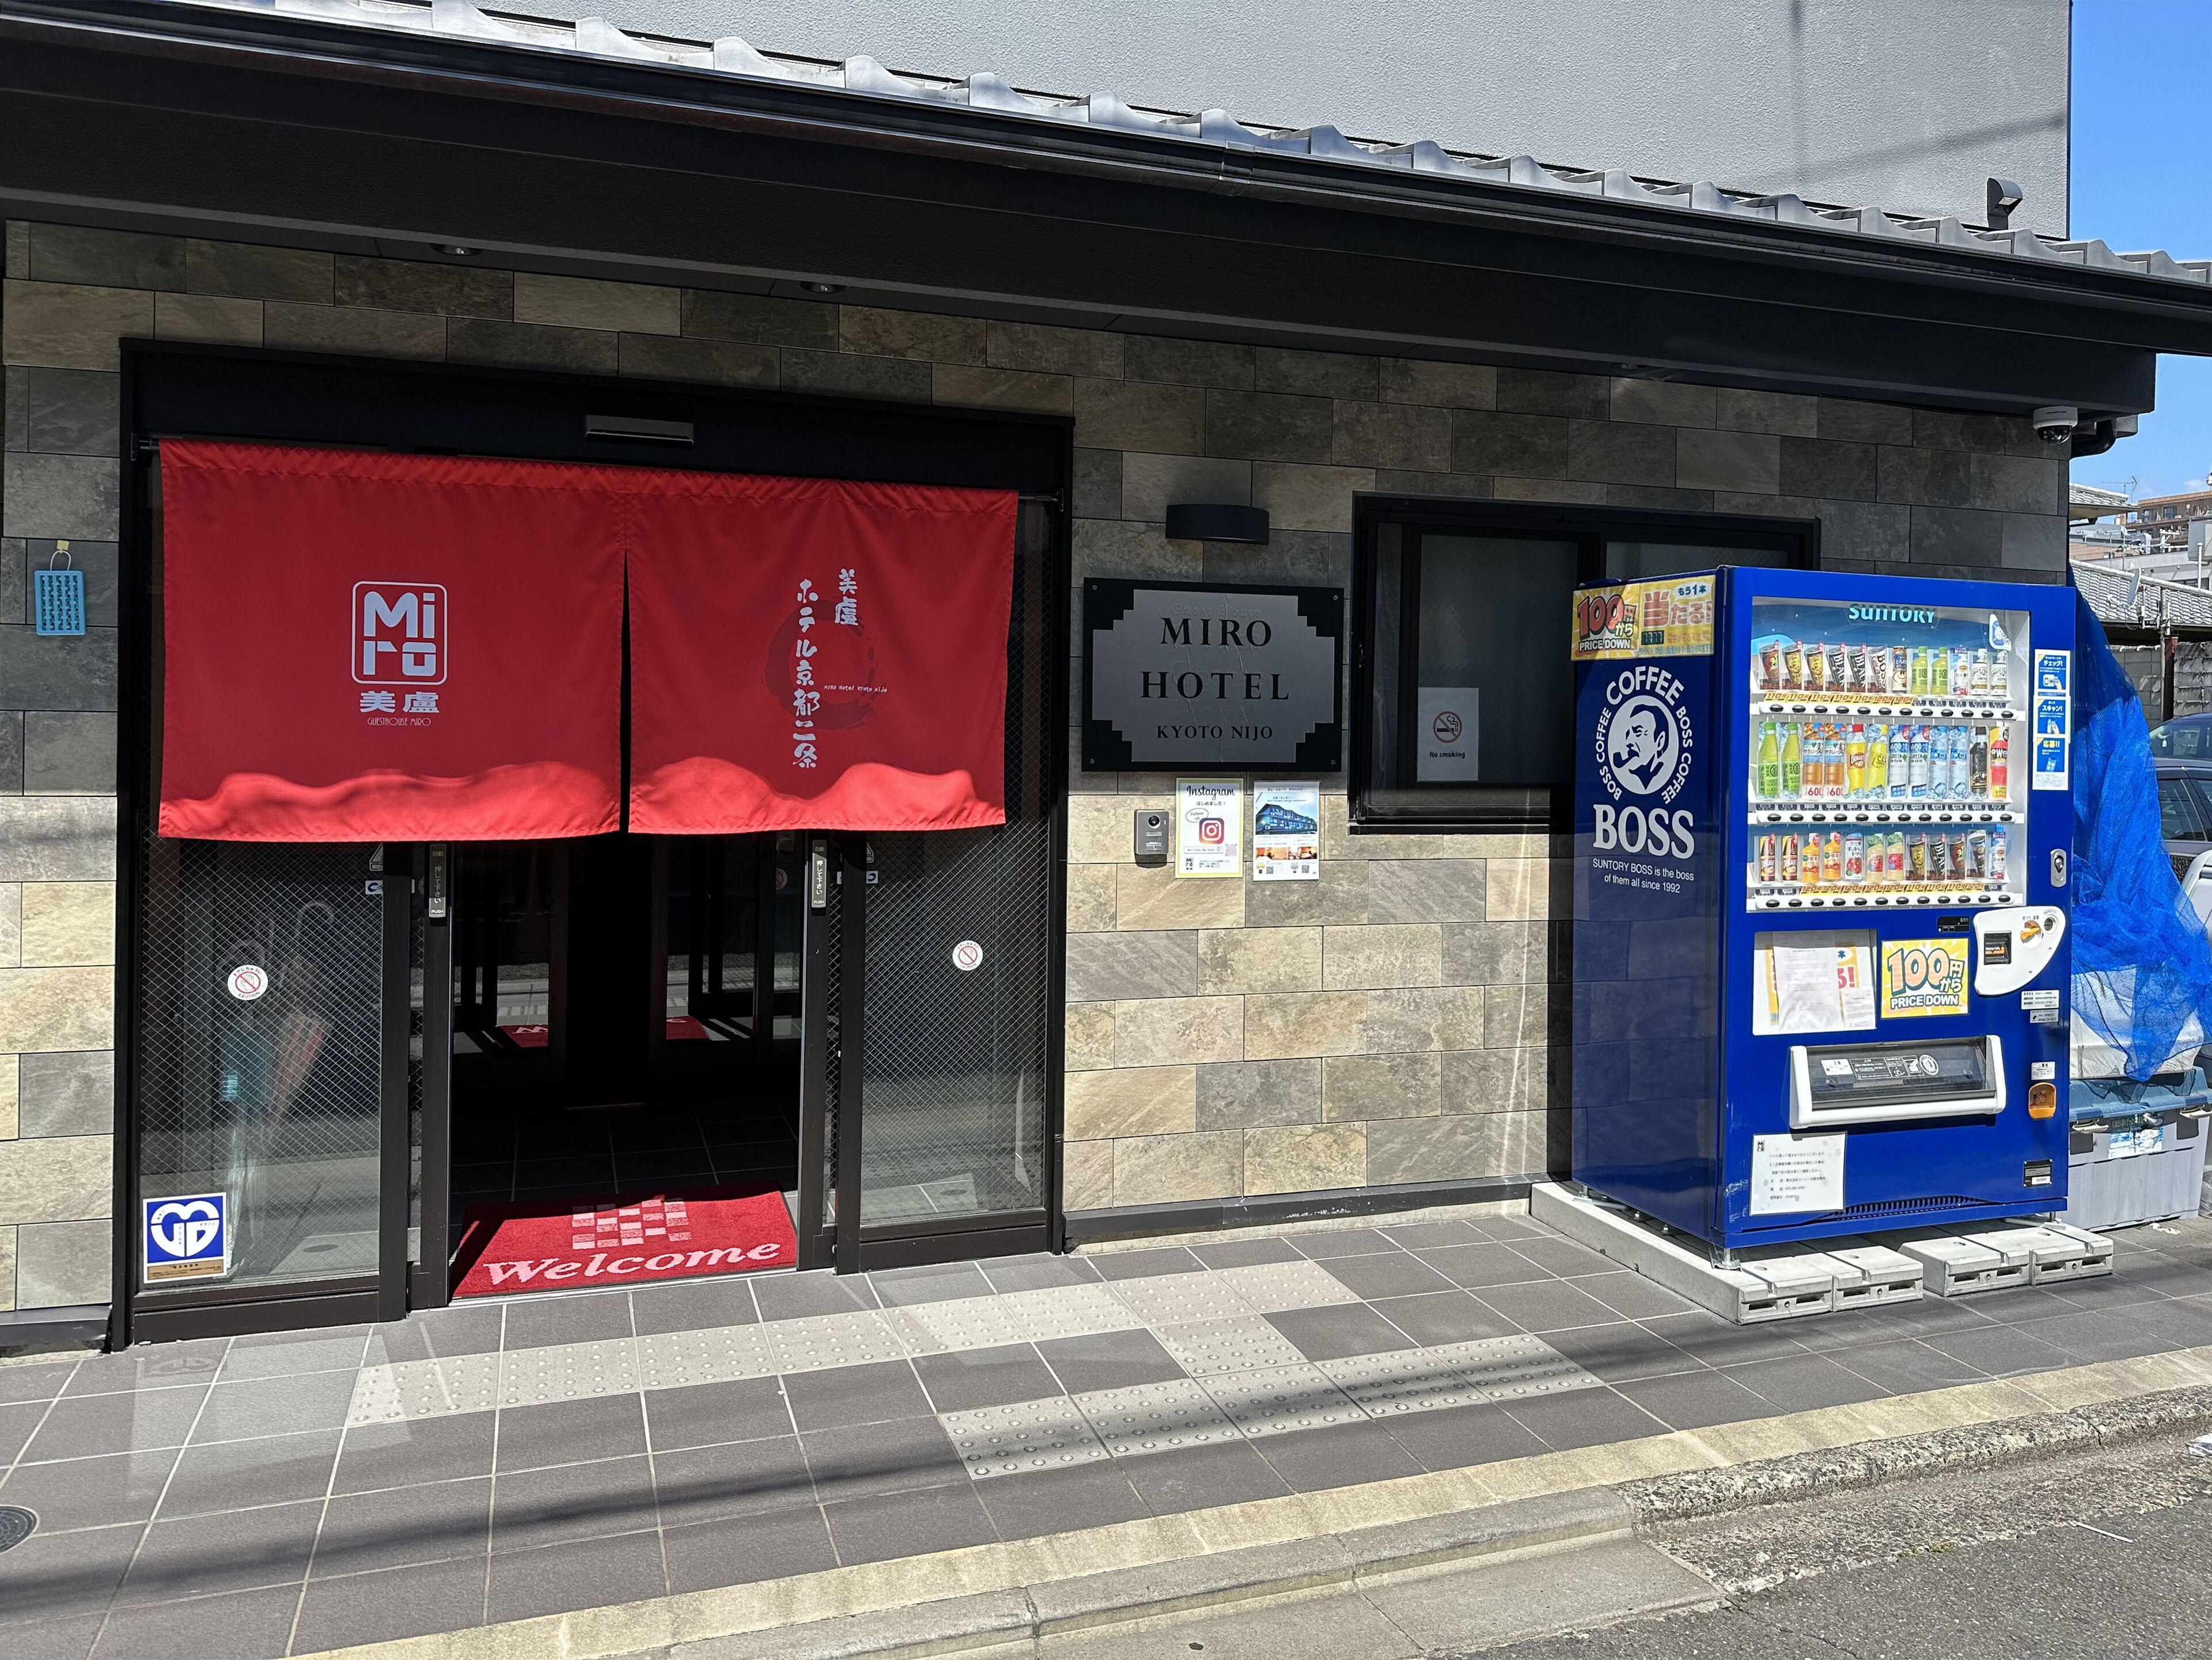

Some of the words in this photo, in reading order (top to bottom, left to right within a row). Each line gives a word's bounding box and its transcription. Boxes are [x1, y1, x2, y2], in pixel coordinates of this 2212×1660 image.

[1849, 603, 1936, 623] SUNTORY
[1160, 617, 1272, 647] MIRO
[1579, 638, 1603, 653] PRICE
[1604, 637, 1631, 650] DOWN
[793, 578, 820, 768] ホテル京都二条
[1140, 671, 1290, 700] HOTEL
[1606, 665, 1684, 706] COFFEE
[368, 717, 408, 726] GUESTHOUSE
[410, 718, 431, 727] MIRO
[1157, 725, 1223, 739] KYOTO
[1231, 725, 1272, 741] NIJO
[1595, 706, 1612, 763] COFFEE
[1676, 706, 1693, 747] BOSS
[1439, 751, 1465, 759] smoking
[1187, 785, 1236, 800] Instagram
[1599, 768, 1623, 801] BOSS
[1661, 752, 1692, 804] COFFEE
[1593, 804, 1695, 860] BOSS
[1593, 858, 1629, 872] SUNTORY
[1631, 863, 1653, 875] BOSS
[1654, 866, 1661, 876] is
[1662, 867, 1675, 878] the
[1676, 868, 1694, 881] boss
[1604, 874, 1612, 883] of
[1612, 874, 1630, 885] them
[1631, 878, 1640, 887] all
[1641, 879, 1660, 890] since
[1662, 882, 1680, 894] 1992
[1891, 994, 1925, 1009] PRICE
[1926, 993, 1959, 1006] DOWN
[483, 1242, 781, 1285] Welcome
